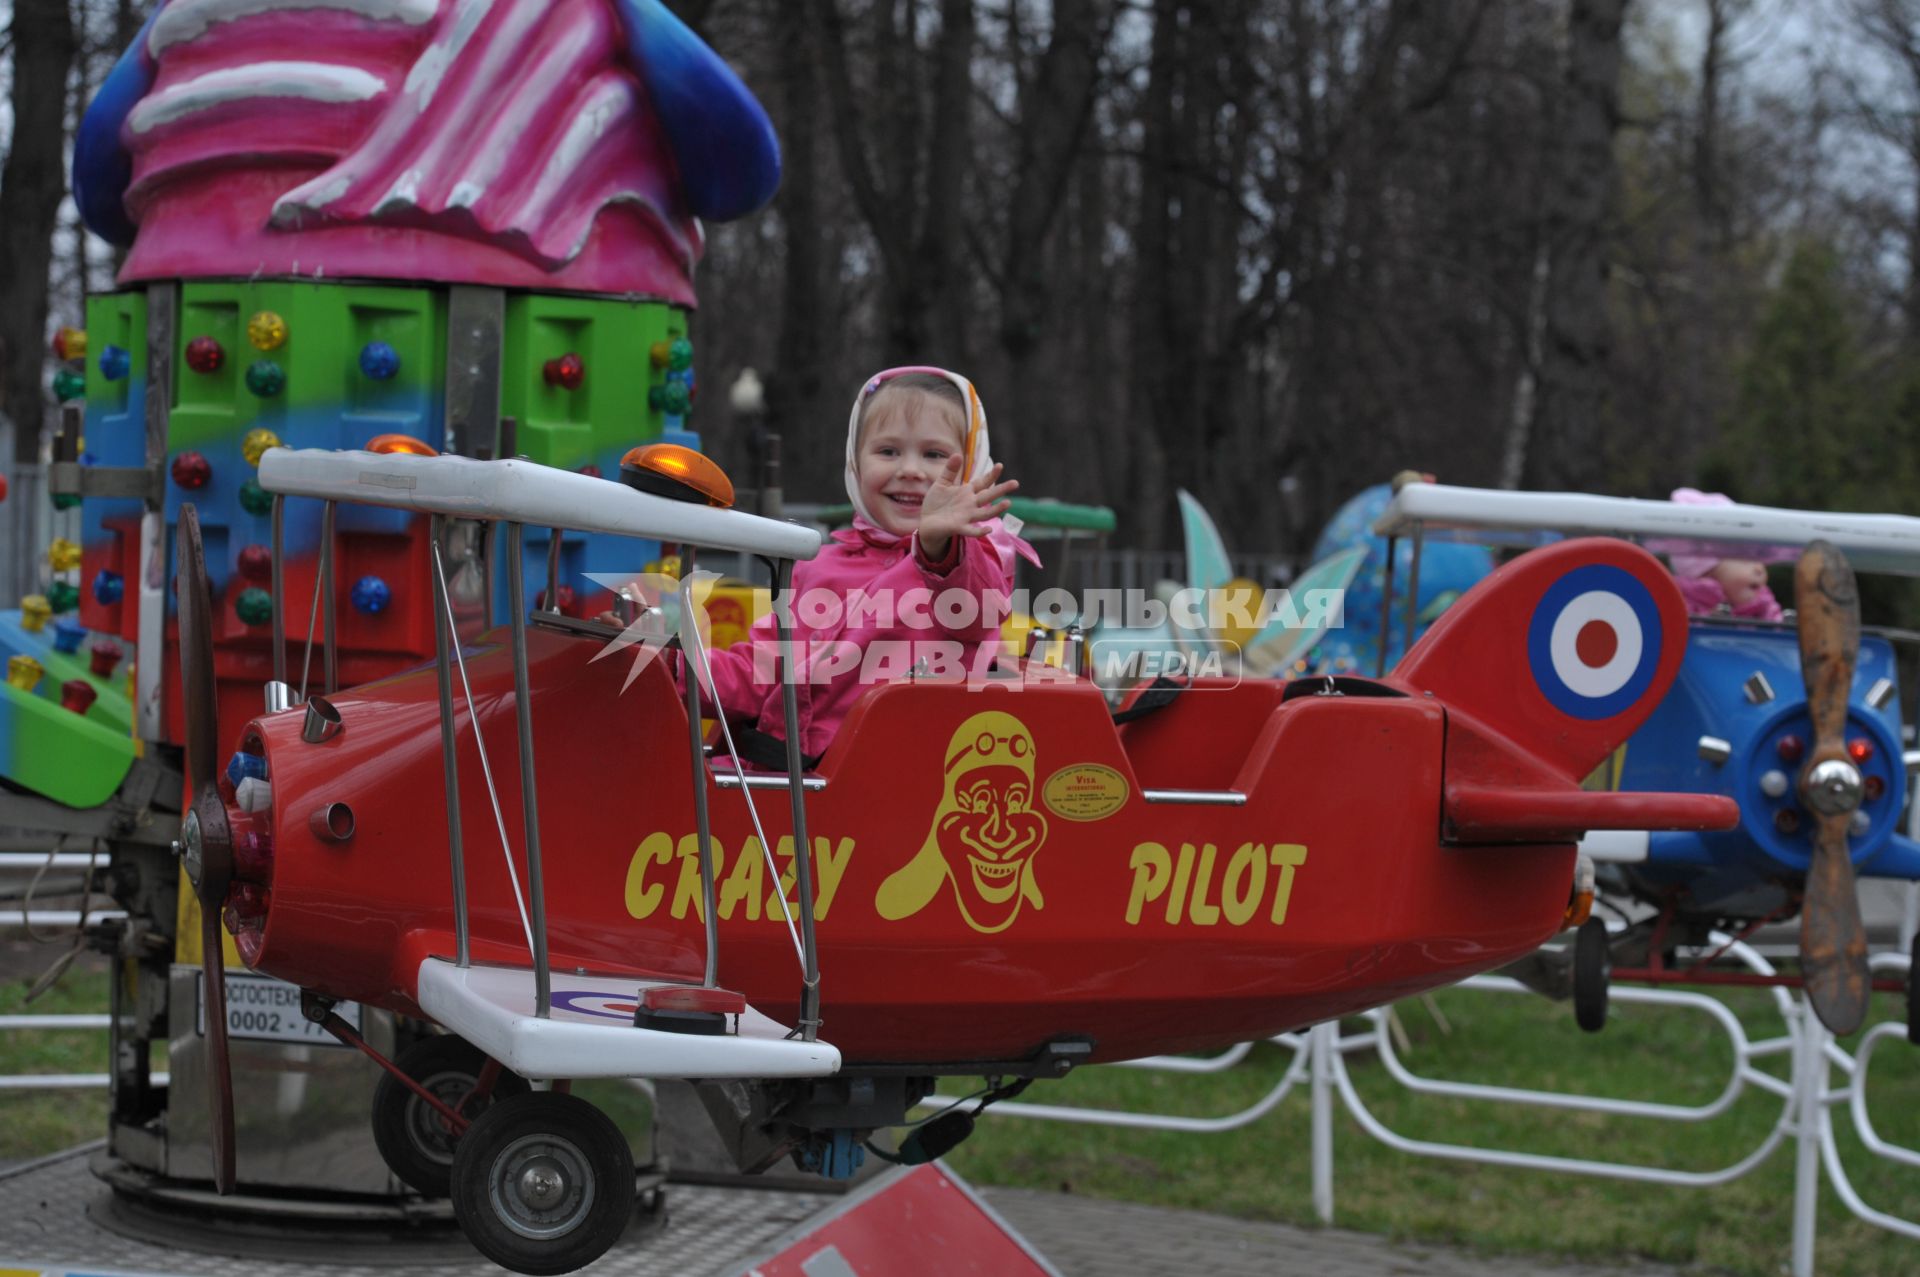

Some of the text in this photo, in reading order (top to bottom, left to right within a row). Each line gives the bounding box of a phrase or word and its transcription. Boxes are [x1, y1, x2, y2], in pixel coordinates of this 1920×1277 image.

[624, 831, 1308, 926] CRAZY PILOT
[229, 1010, 281, 1033] 0002
